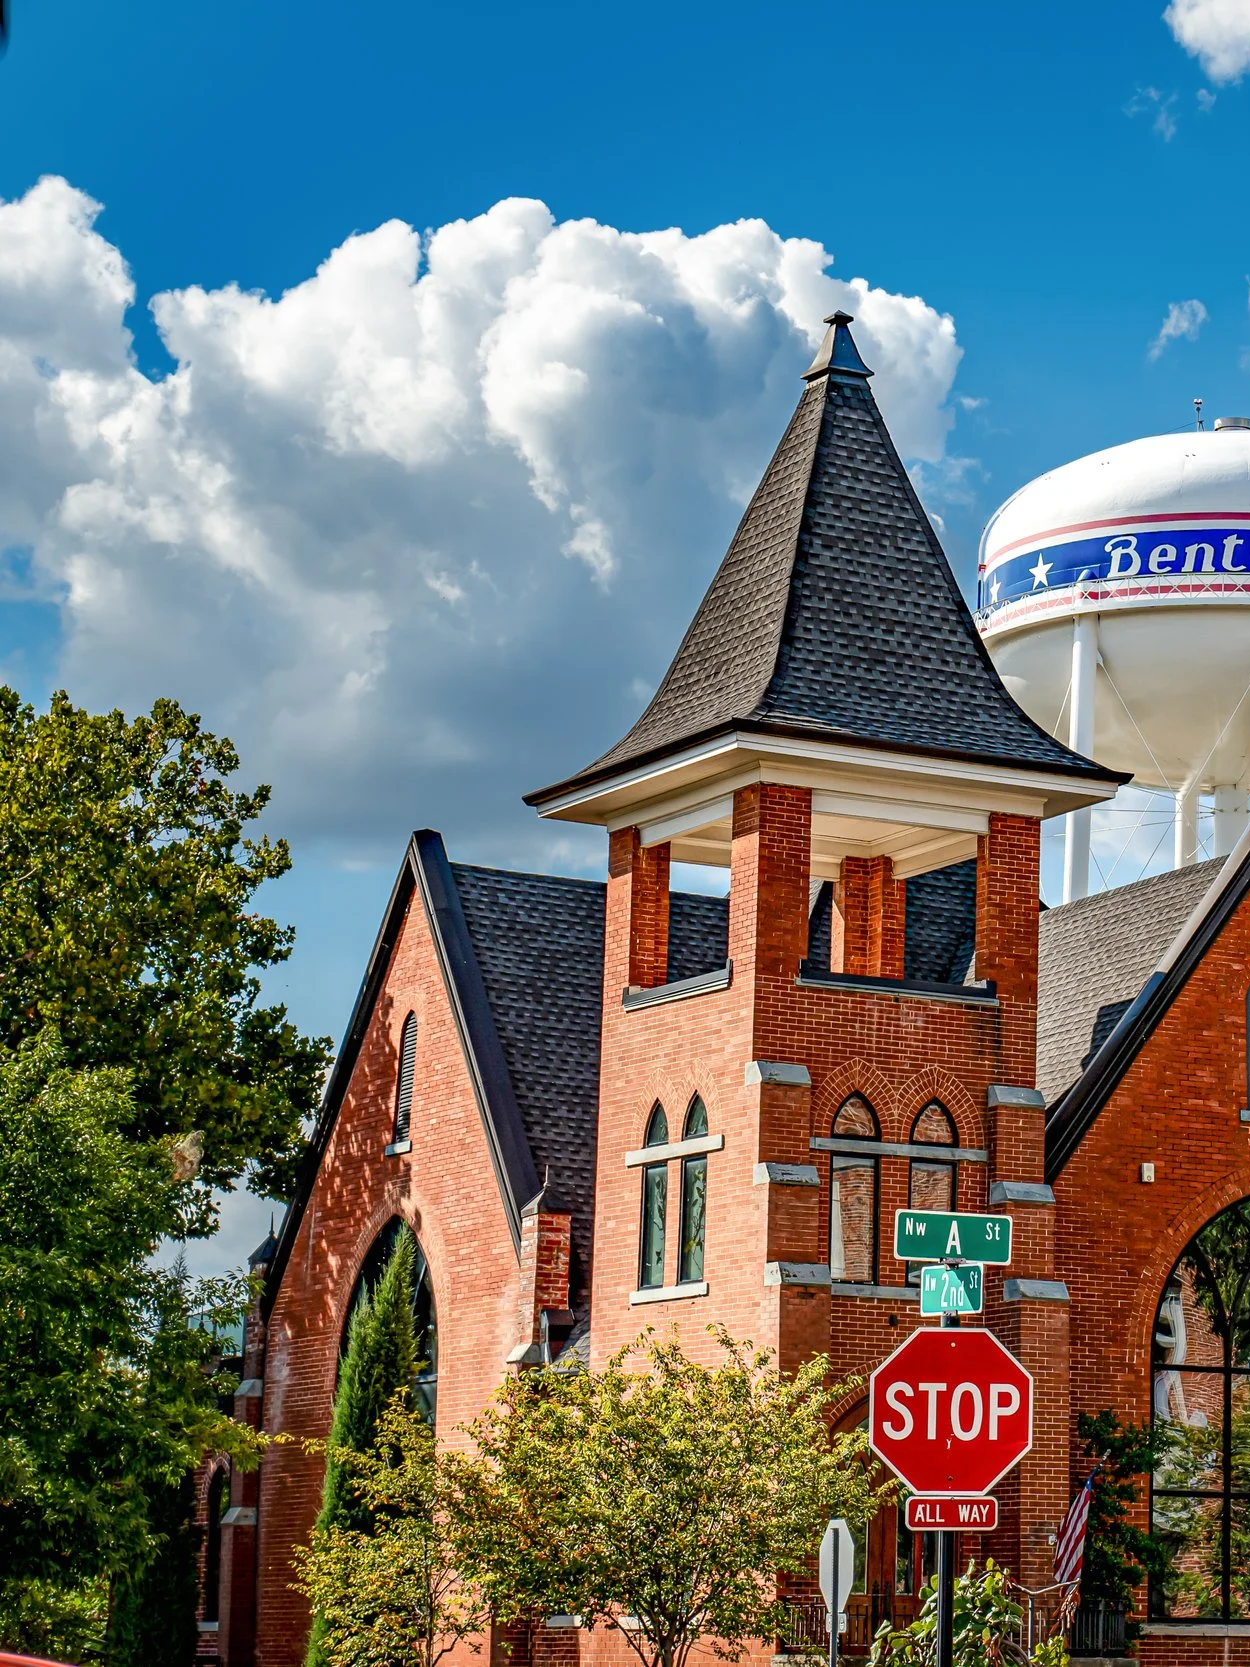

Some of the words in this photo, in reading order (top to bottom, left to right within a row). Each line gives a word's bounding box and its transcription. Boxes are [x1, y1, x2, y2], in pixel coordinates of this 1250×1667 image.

[945, 1220, 962, 1255] A
[985, 1222, 1001, 1241] St
[940, 1272, 965, 1308] 2nd
[969, 1271, 978, 1289] St
[882, 1381, 1021, 1442] STOP
[914, 1503, 945, 1523] ALL
[958, 1504, 990, 1523] WAY
